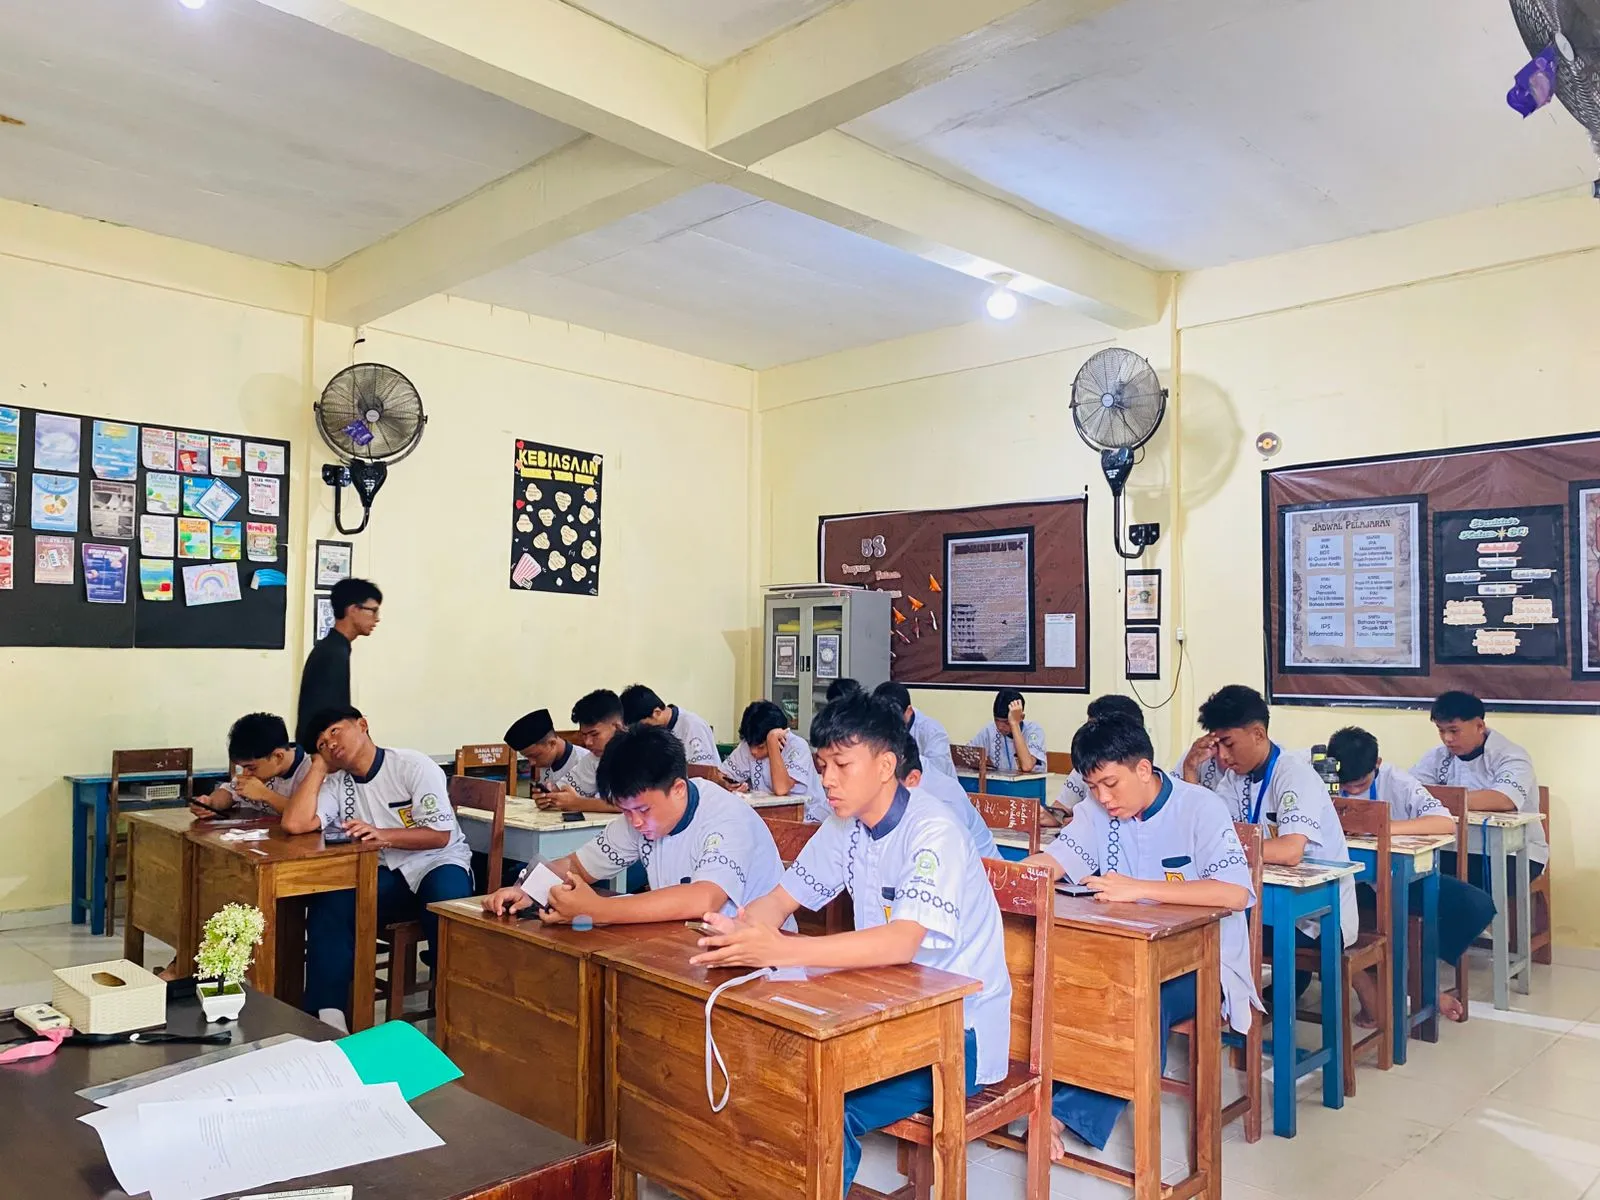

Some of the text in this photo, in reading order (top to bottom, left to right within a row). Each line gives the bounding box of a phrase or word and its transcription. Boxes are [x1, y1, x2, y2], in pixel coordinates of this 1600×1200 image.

[518, 449, 599, 476] KEBIASAAN
[1312, 519, 1391, 532] JADWAL PELAJARAN
